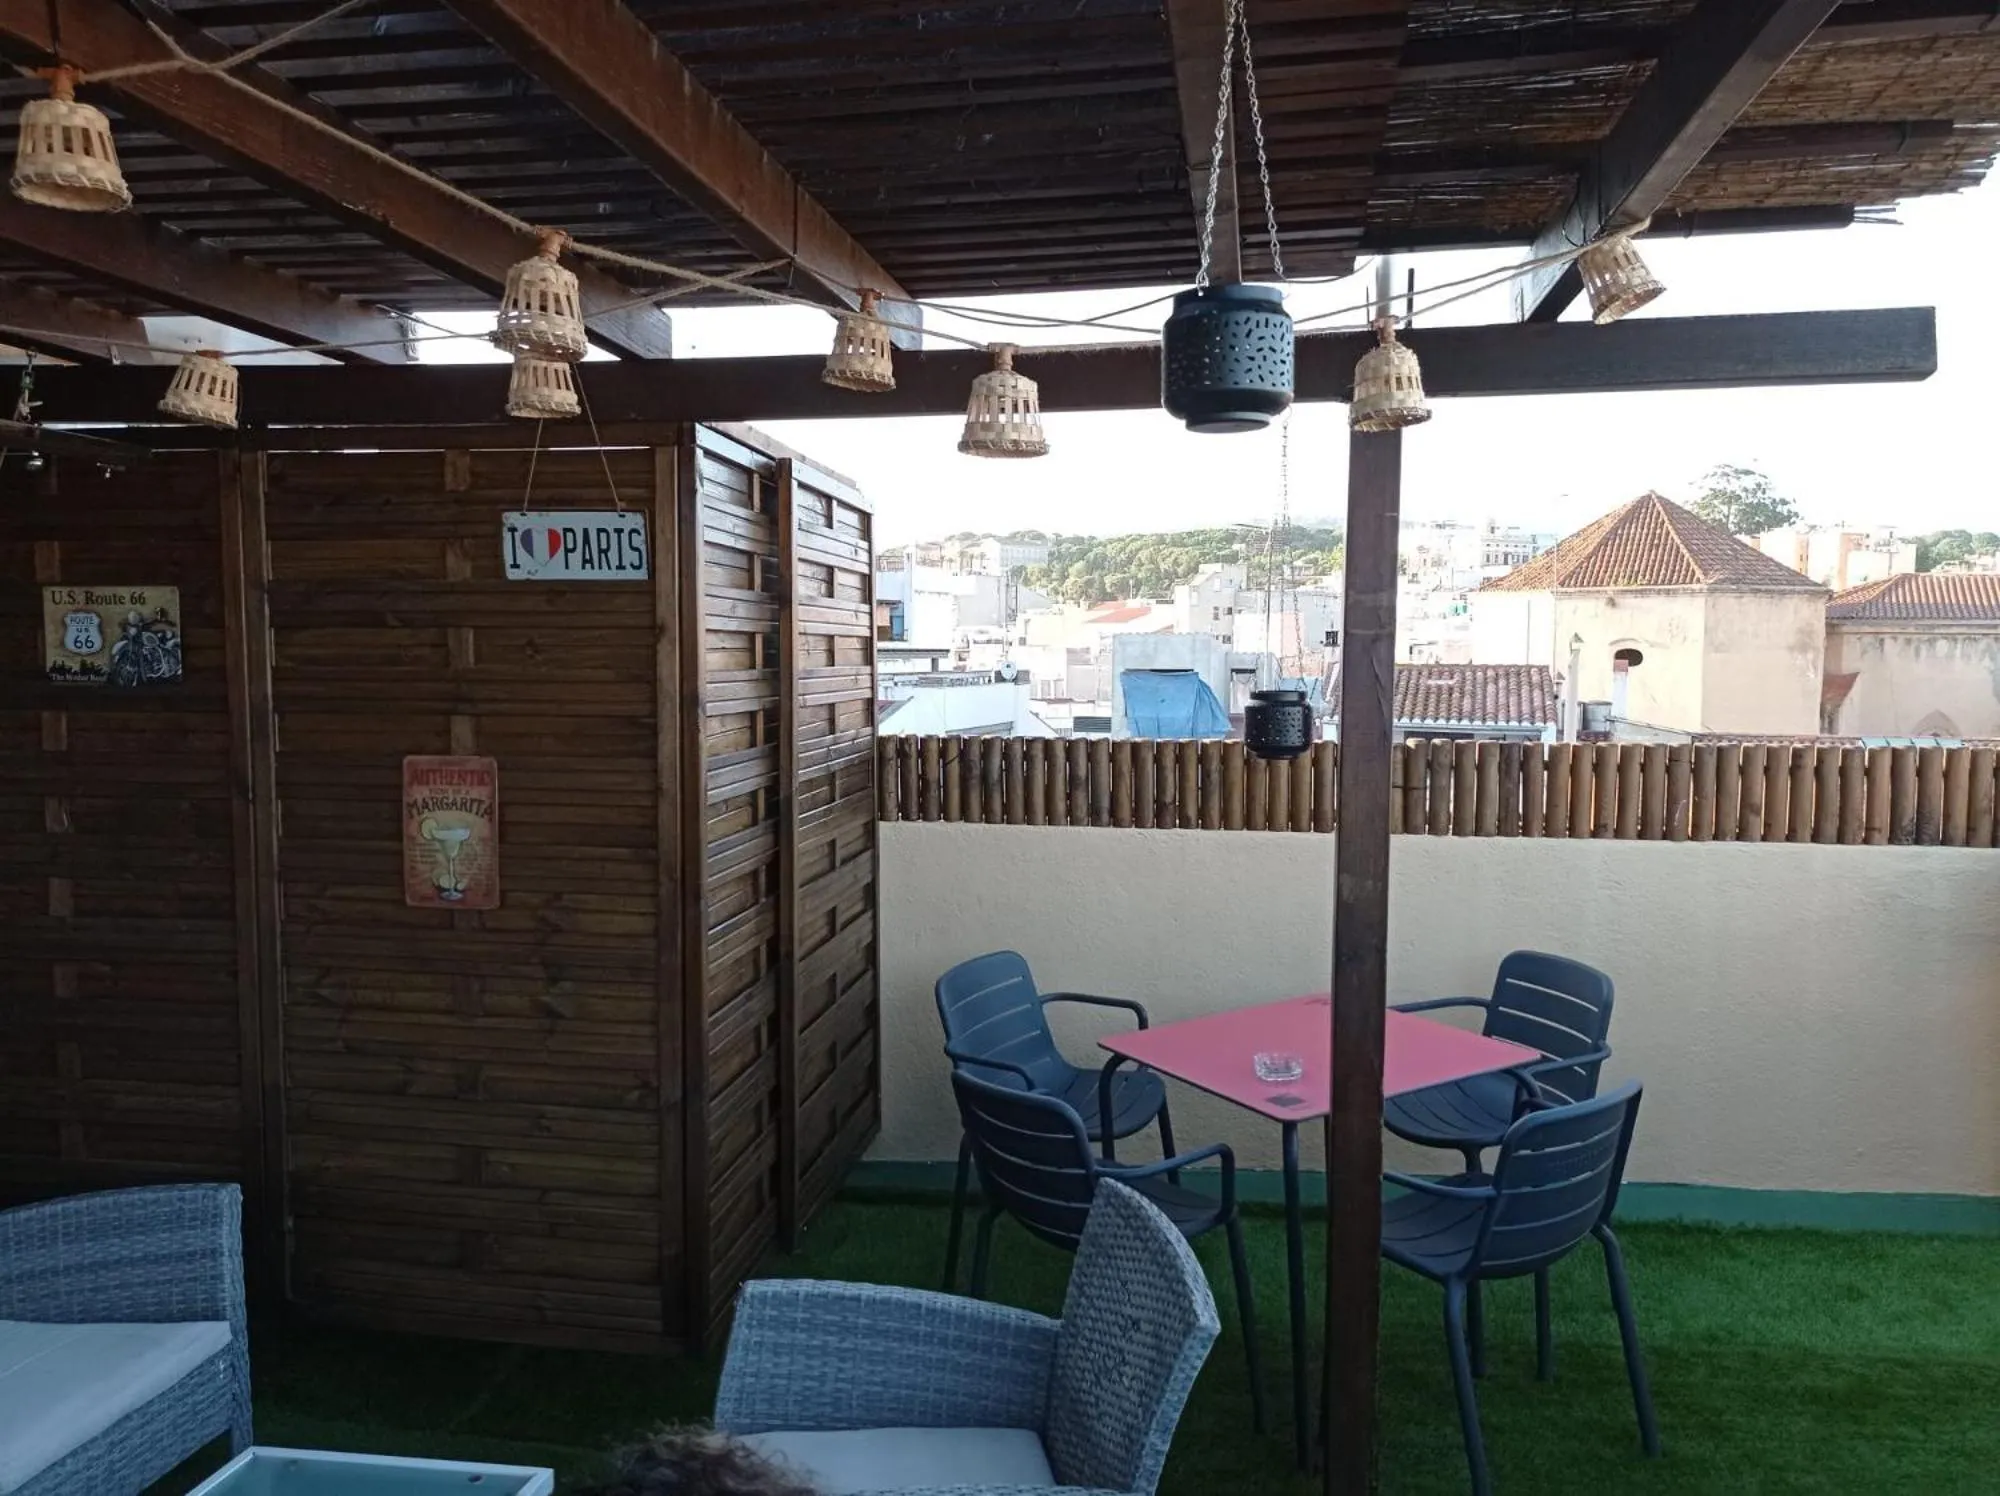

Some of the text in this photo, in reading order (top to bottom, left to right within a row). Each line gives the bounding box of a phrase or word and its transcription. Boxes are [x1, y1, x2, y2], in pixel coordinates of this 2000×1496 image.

[507, 526, 644, 571] I PARIS
[51, 590, 146, 605] U.S. Route 66
[70, 615, 94, 625] ROUTE
[74, 635, 95, 649] 66
[408, 768, 491, 787] AUTHENTIC
[406, 795, 494, 822] MARGARITA
